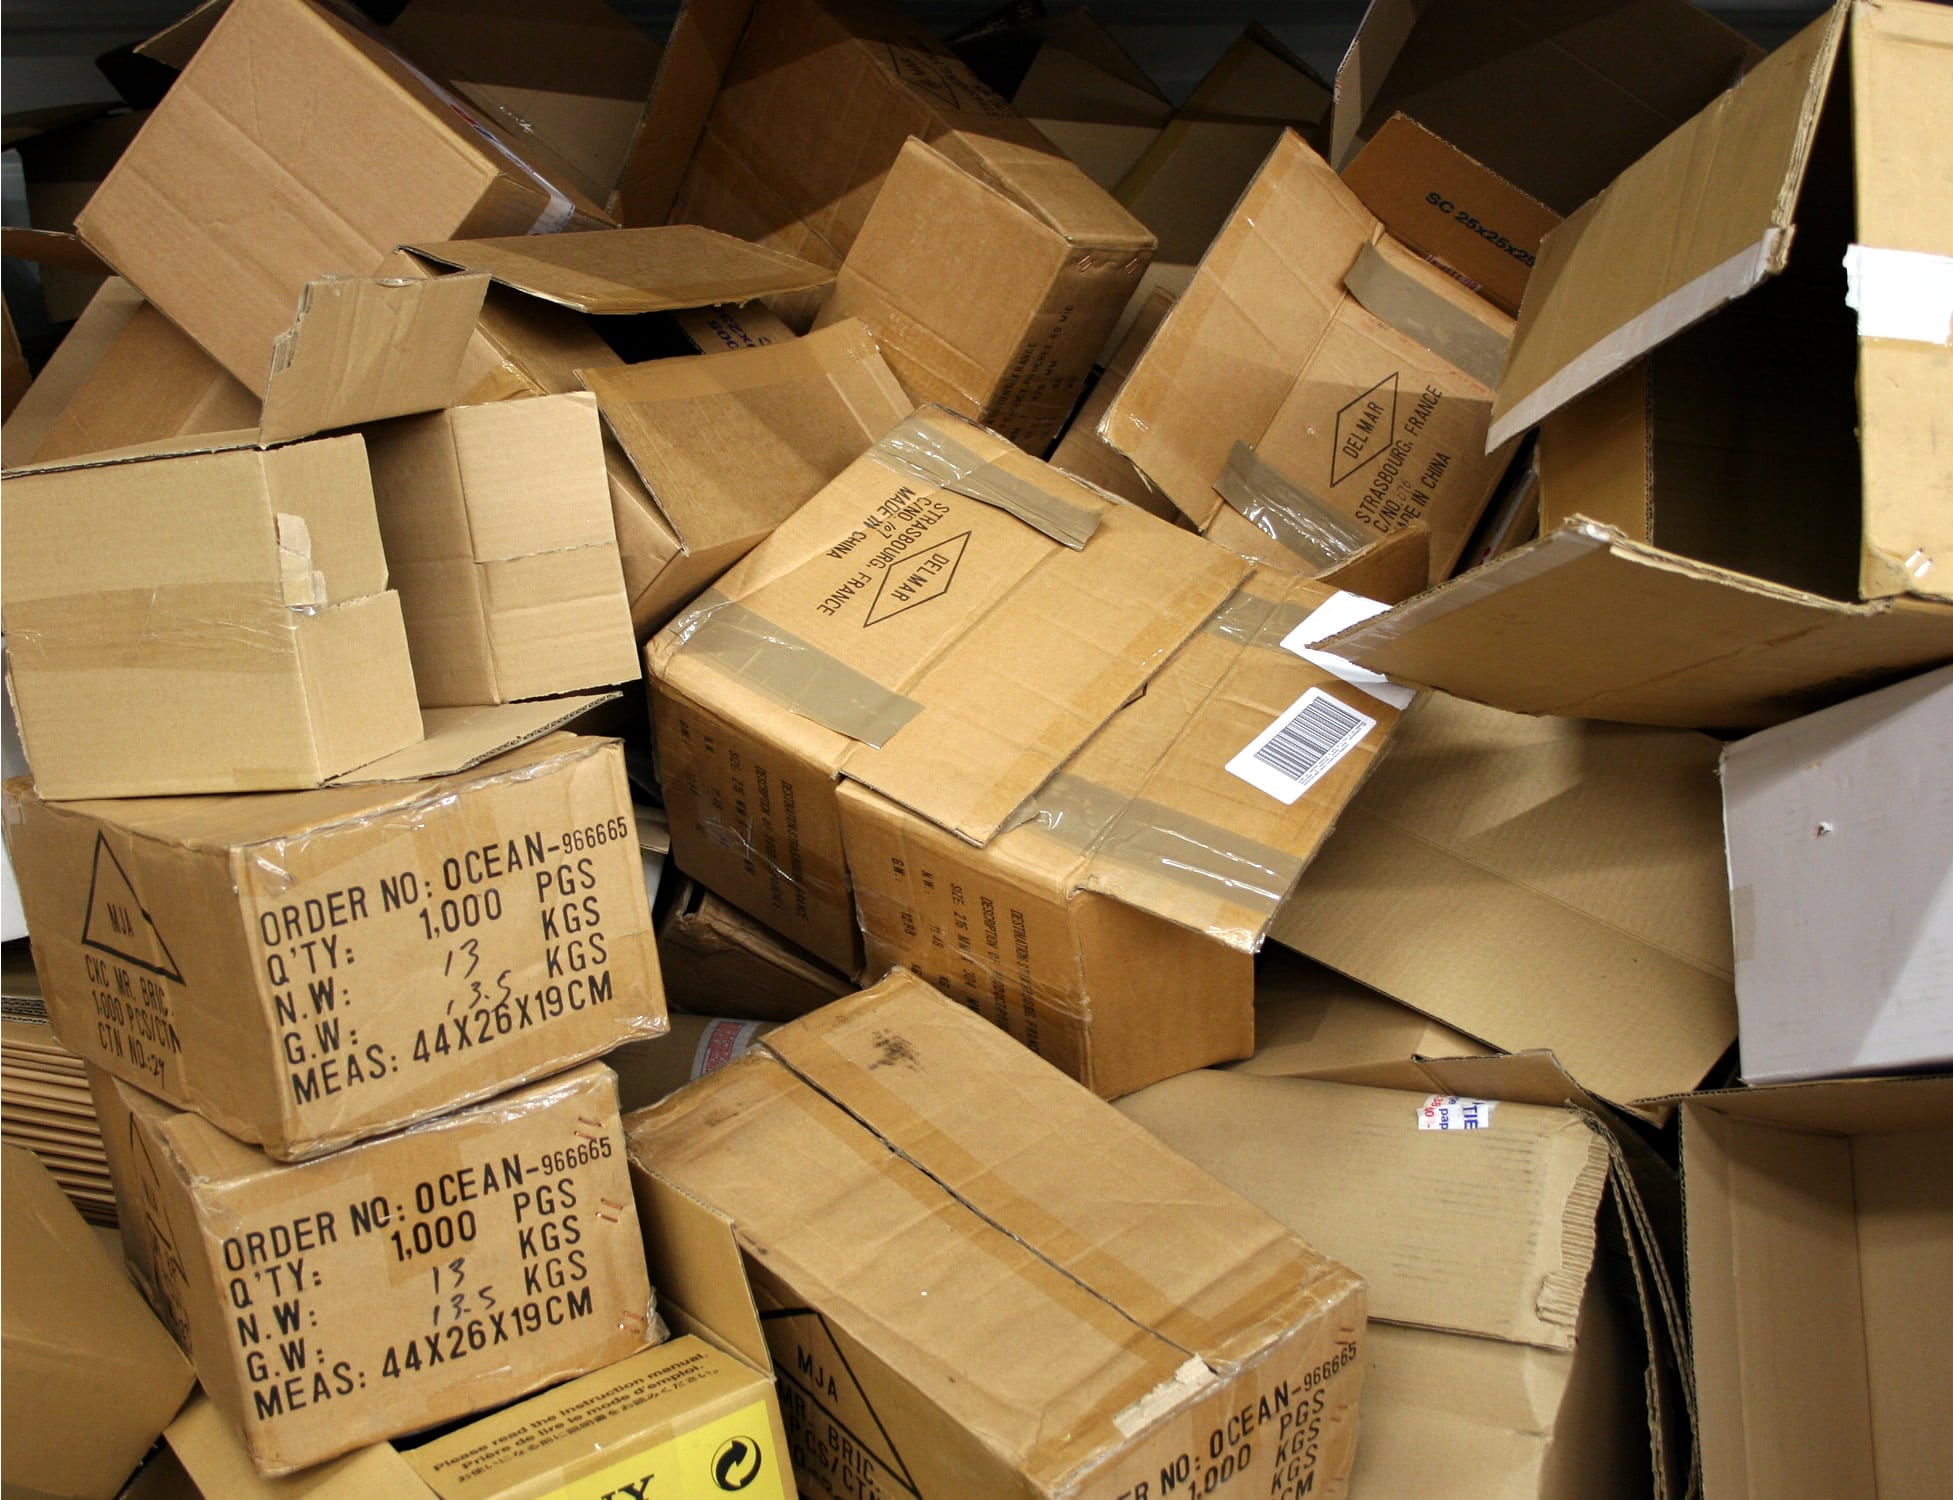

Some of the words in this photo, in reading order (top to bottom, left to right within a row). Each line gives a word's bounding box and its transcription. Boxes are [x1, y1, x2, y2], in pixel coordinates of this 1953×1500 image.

[1425, 191, 1455, 214] SC
[1342, 401, 1385, 460] DELMAR
[1355, 440, 1415, 524] STRASBOURG,
[1404, 384, 1443, 437] FRANCE
[877, 486, 917, 519] MADE
[1394, 504, 1422, 530] ADE
[1410, 489, 1431, 508] IN
[1421, 452, 1453, 489] CHINA
[826, 530, 867, 559] CHINA
[863, 515, 883, 530] IN
[865, 502, 950, 569] STRASBOURG,
[816, 571, 872, 617] FRANCE
[891, 552, 950, 602] DELMAR
[260, 886, 369, 946] ORDER
[380, 871, 434, 913] NO:
[442, 816, 629, 891] OCEAN-966665
[107, 902, 134, 937] MJA
[266, 934, 355, 986] Q'TY:
[419, 888, 502, 939] 1,000
[535, 858, 597, 903] PGS
[541, 895, 602, 940] KGS
[545, 932, 608, 979] KGS
[98, 1021, 124, 1058] CTN
[291, 1043, 399, 1105] MEAS:
[412, 970, 613, 1063] 44X26X19CM
[222, 1210, 337, 1272] ORDER
[349, 1196, 405, 1237] NO:
[415, 1136, 613, 1214] OCEAN-966665
[229, 1258, 323, 1309] Q'TY:
[391, 1210, 477, 1262] 1,000
[513, 1178, 577, 1224] PGS
[433, 1257, 466, 1294] 13
[519, 1214, 582, 1260] KGS
[524, 1249, 589, 1296] KGS
[253, 1361, 367, 1421] MEAS:
[382, 1286, 594, 1379] 44X26X19CM
[798, 1344, 839, 1403] MJA
[1209, 1342, 1357, 1459] OCEAN-966665
[1279, 1388, 1326, 1441] PGS
[433, 1439, 489, 1472] Please
[491, 1423, 528, 1448] read
[529, 1411, 558, 1433] the
[461, 1442, 513, 1470] Prière
[514, 1429, 536, 1447] de
[537, 1417, 567, 1438] lire
[568, 1411, 584, 1426] le
[586, 1391, 631, 1419] mode
[1275, 1417, 1322, 1468] KGS
[1271, 1444, 1319, 1496] KGS
